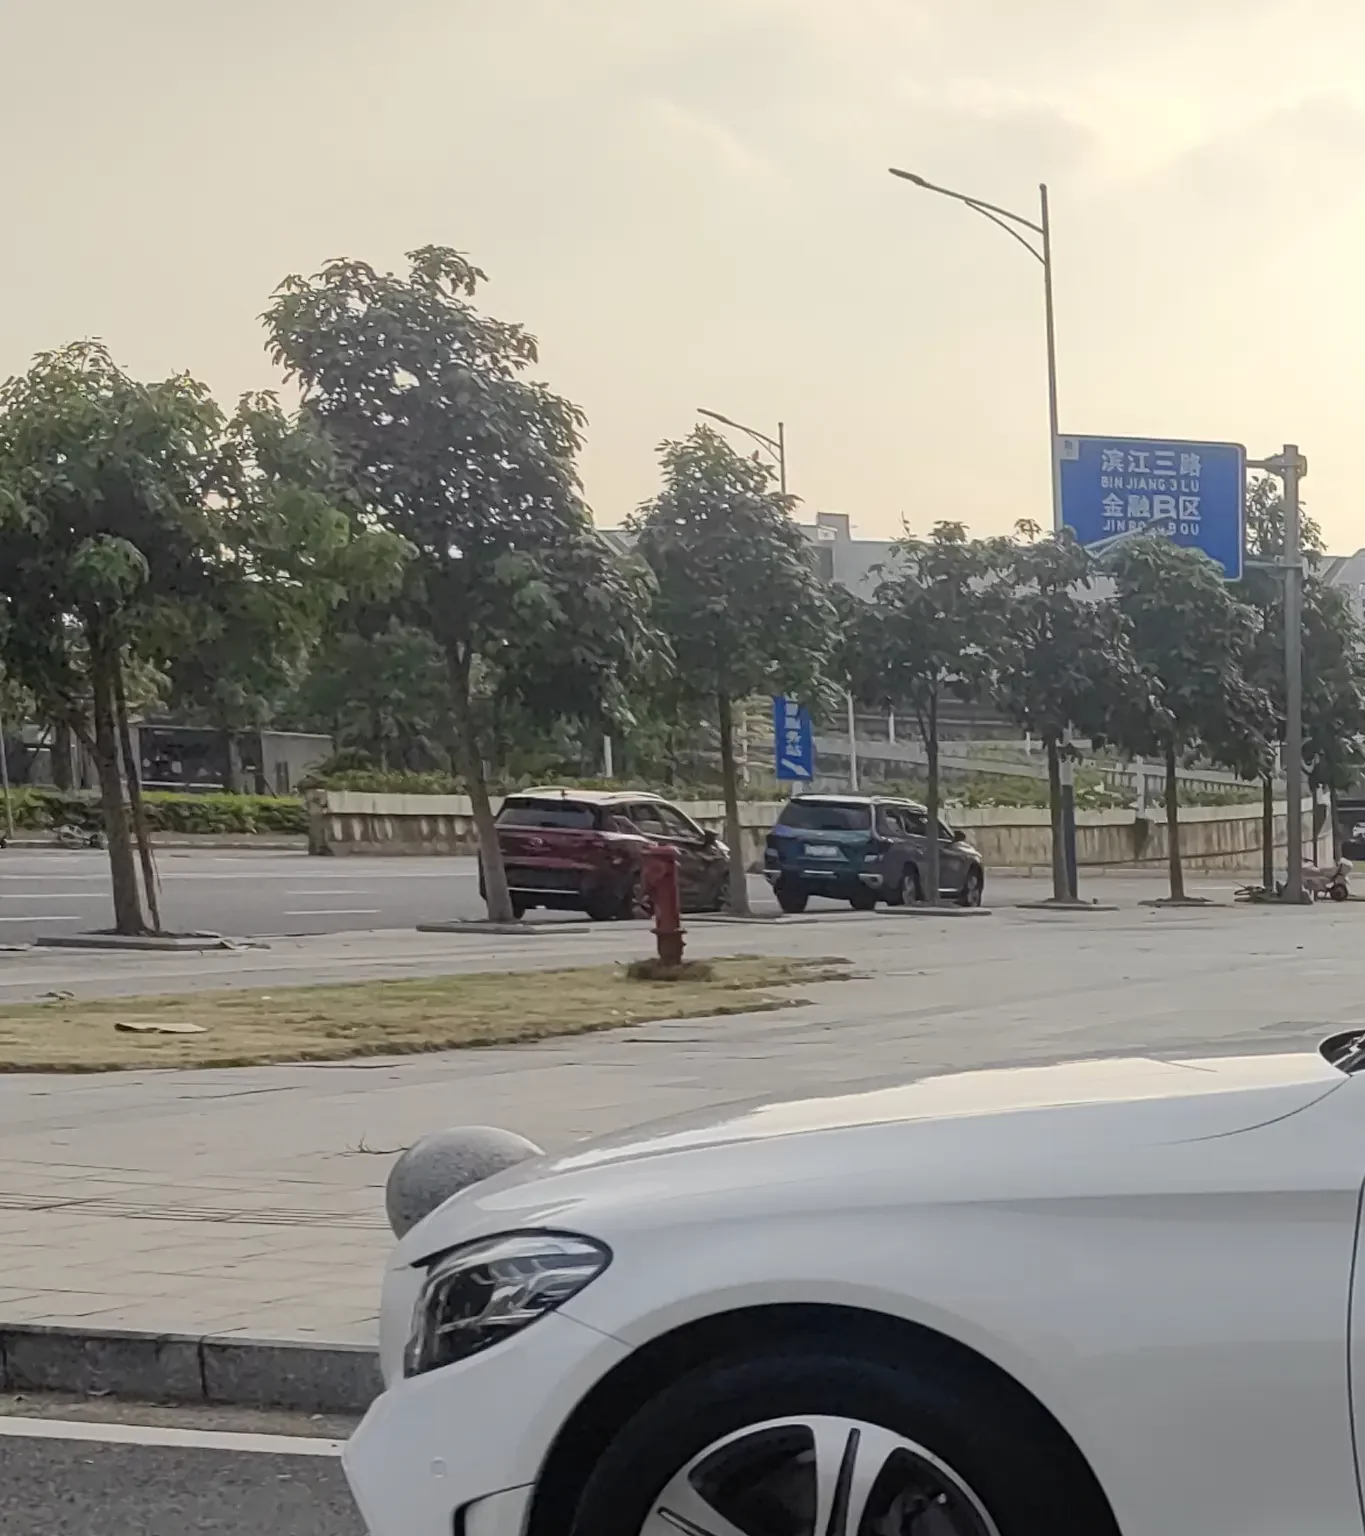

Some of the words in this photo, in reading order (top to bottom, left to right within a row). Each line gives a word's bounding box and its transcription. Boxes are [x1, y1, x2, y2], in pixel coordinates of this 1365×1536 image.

[1101, 448, 1201, 476] 滨江三路
[1101, 476, 1123, 489] BIN
[1126, 477, 1166, 491] JIANG
[1180, 479, 1200, 492] LU
[1101, 492, 1201, 520] 金融B区
[1103, 519, 1125, 532] JIN
[1180, 522, 1200, 536] QU
